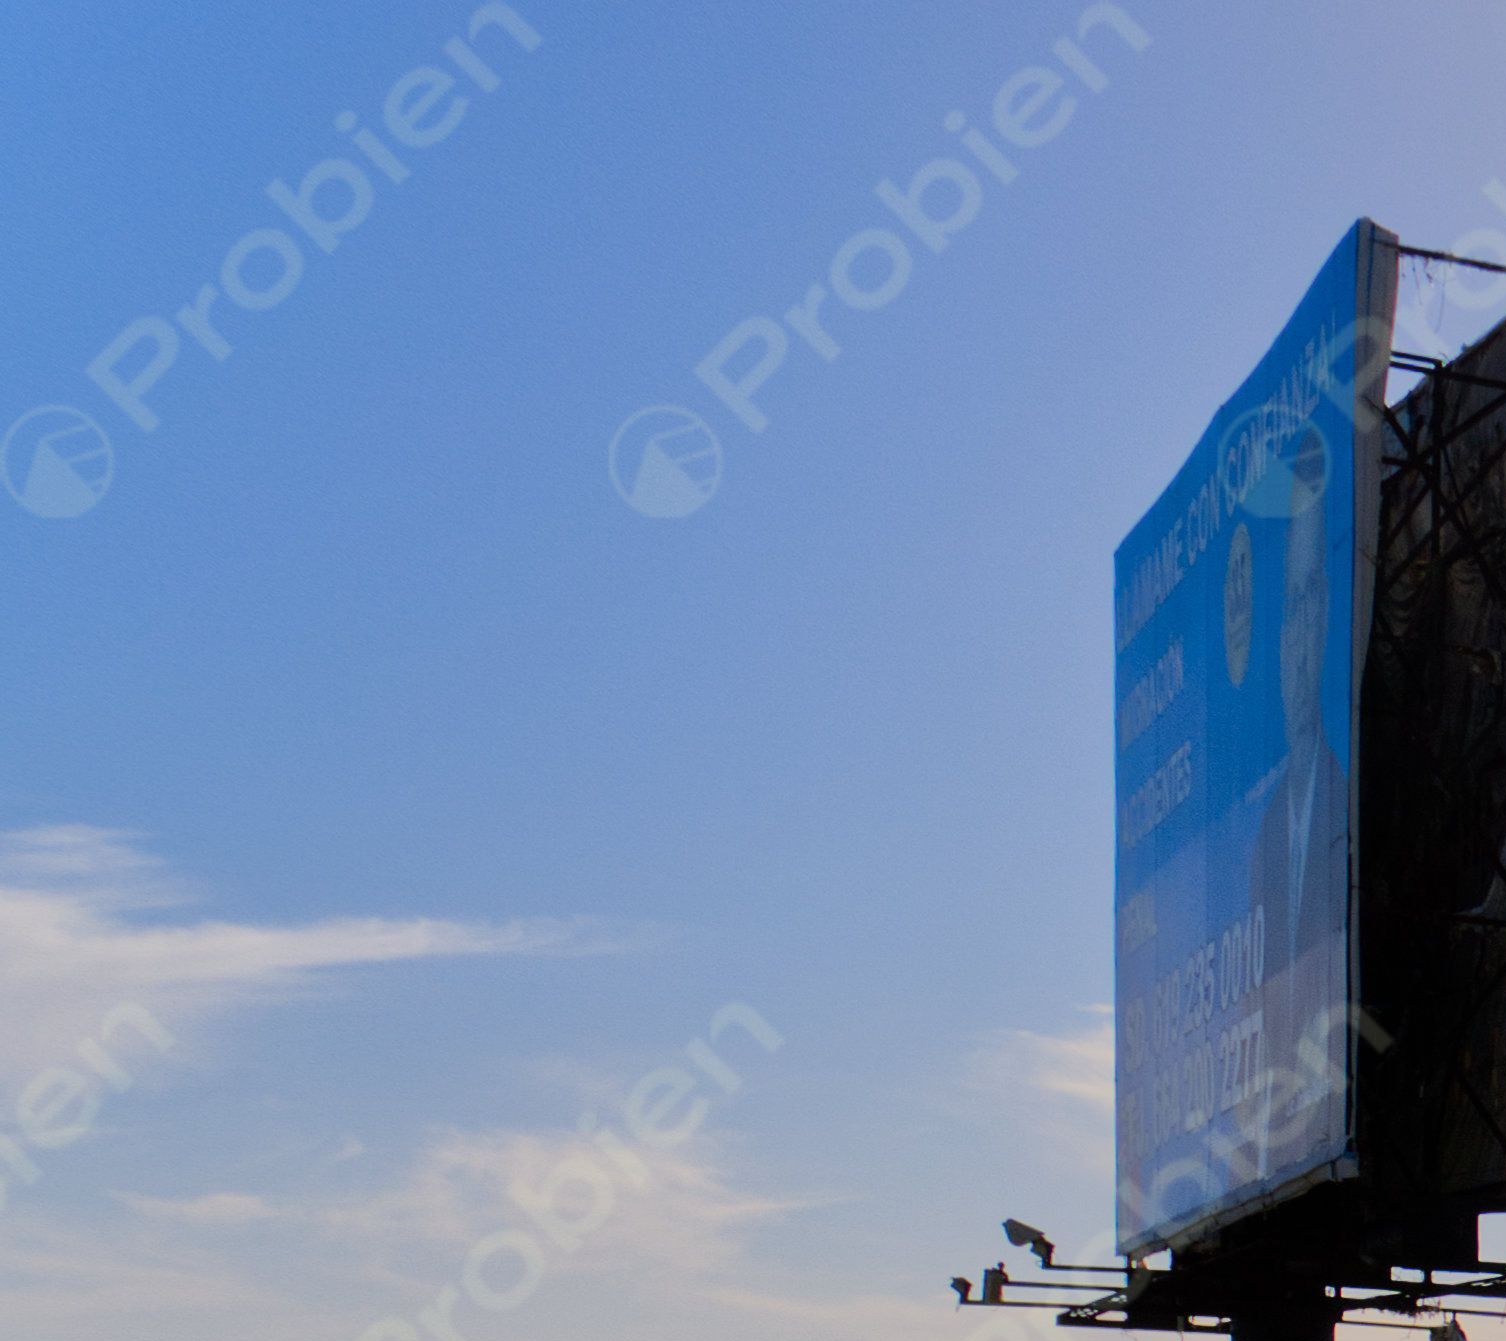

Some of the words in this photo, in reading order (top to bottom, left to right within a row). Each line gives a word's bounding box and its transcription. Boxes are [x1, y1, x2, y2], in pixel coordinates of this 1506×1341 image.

[1187, 471, 1220, 567] CON
[1153, 969, 1180, 1052] 619
[1184, 942, 1214, 1033] 235
[1220, 904, 1265, 1010] 0010
[1184, 1043, 1214, 1132] 200
[1220, 1010, 1264, 1111] 2277
